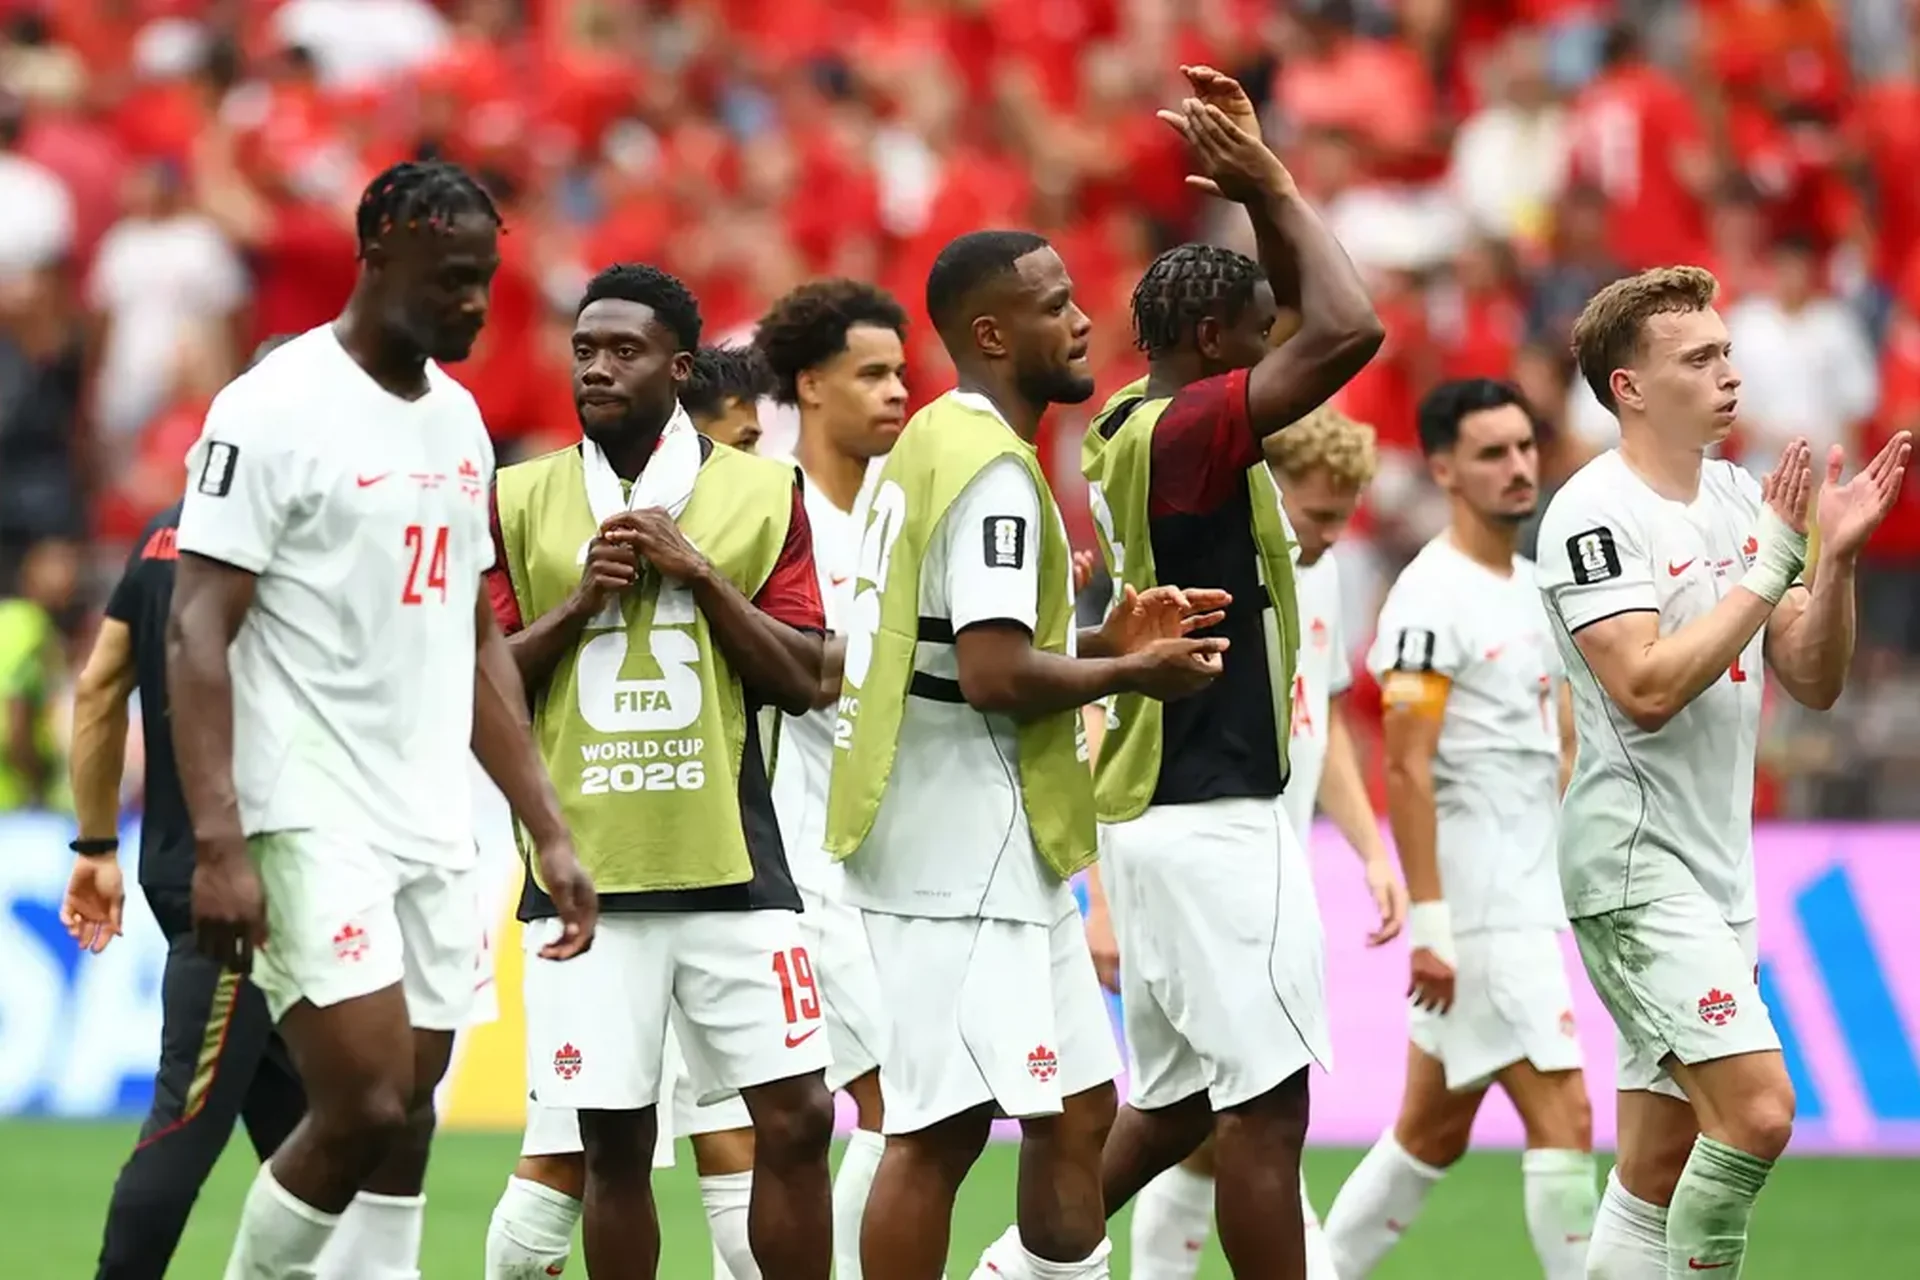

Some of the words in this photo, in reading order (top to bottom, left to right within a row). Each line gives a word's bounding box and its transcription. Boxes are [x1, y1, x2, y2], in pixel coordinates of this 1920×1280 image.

[402, 525, 449, 606] 24
[613, 690, 672, 713] FIFA
[581, 739, 658, 762] WORLD
[663, 738, 704, 757] CUP
[580, 761, 705, 795] 2026
[772, 946, 820, 1024] 19
